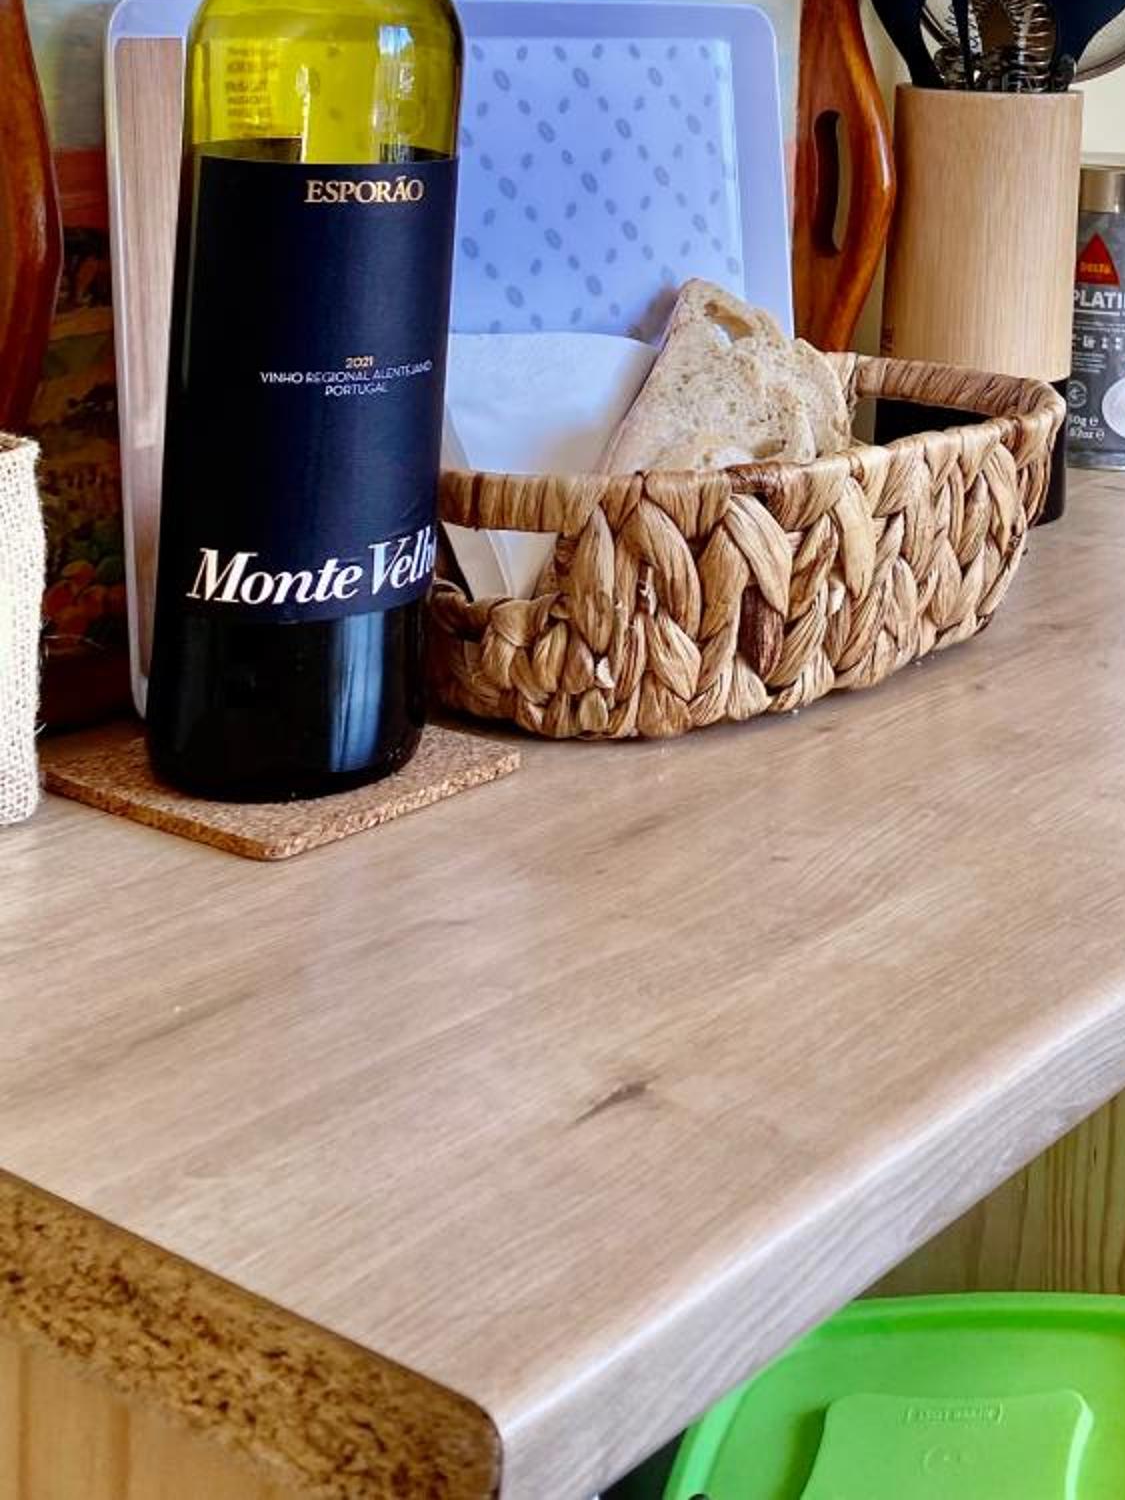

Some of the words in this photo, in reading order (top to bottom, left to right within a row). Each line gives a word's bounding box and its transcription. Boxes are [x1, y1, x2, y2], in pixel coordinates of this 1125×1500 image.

[304, 175, 424, 203] ESPORÃO
[345, 355, 374, 369] 2021
[260, 371, 304, 385] VINHO
[305, 369, 370, 384] REGIONAL
[324, 381, 388, 397] PORTUGAL
[186, 547, 364, 605] Monte
[368, 525, 437, 596] Velh
